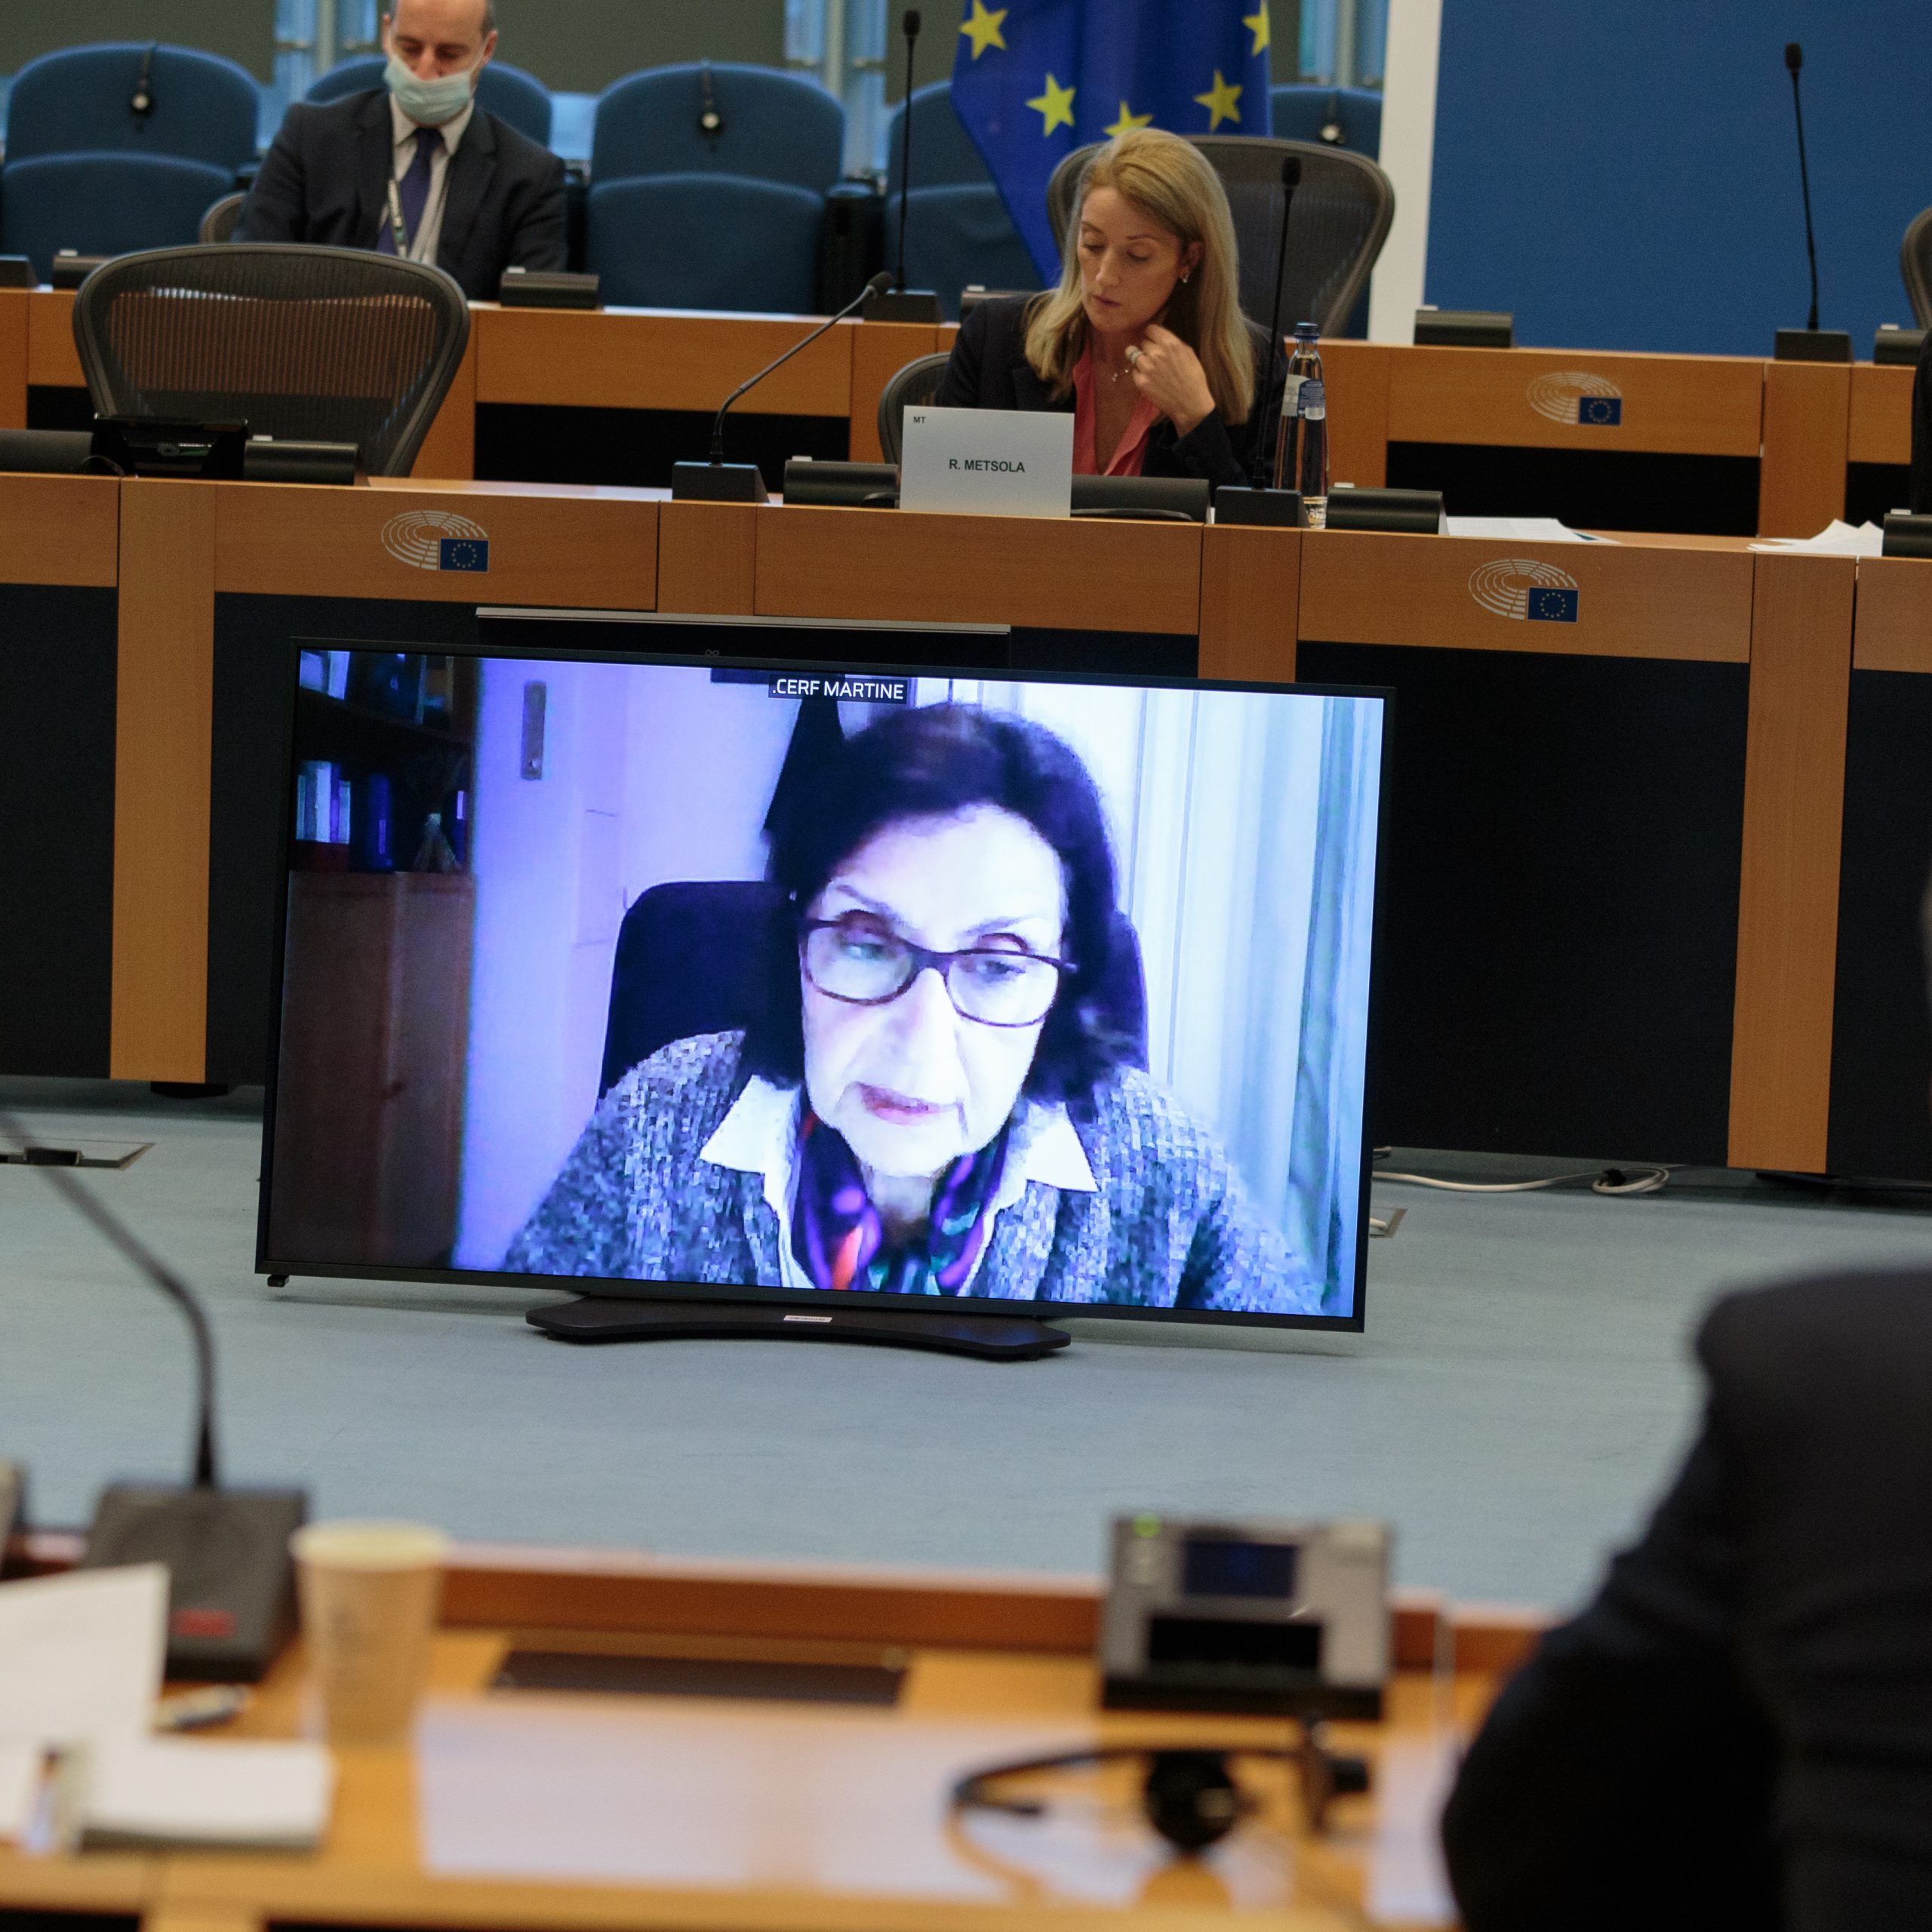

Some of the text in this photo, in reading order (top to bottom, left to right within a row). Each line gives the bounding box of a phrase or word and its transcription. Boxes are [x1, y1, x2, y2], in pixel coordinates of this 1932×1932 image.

[949, 459, 1026, 472] R. METSOLA
[823, 681, 904, 700] MARTINE
